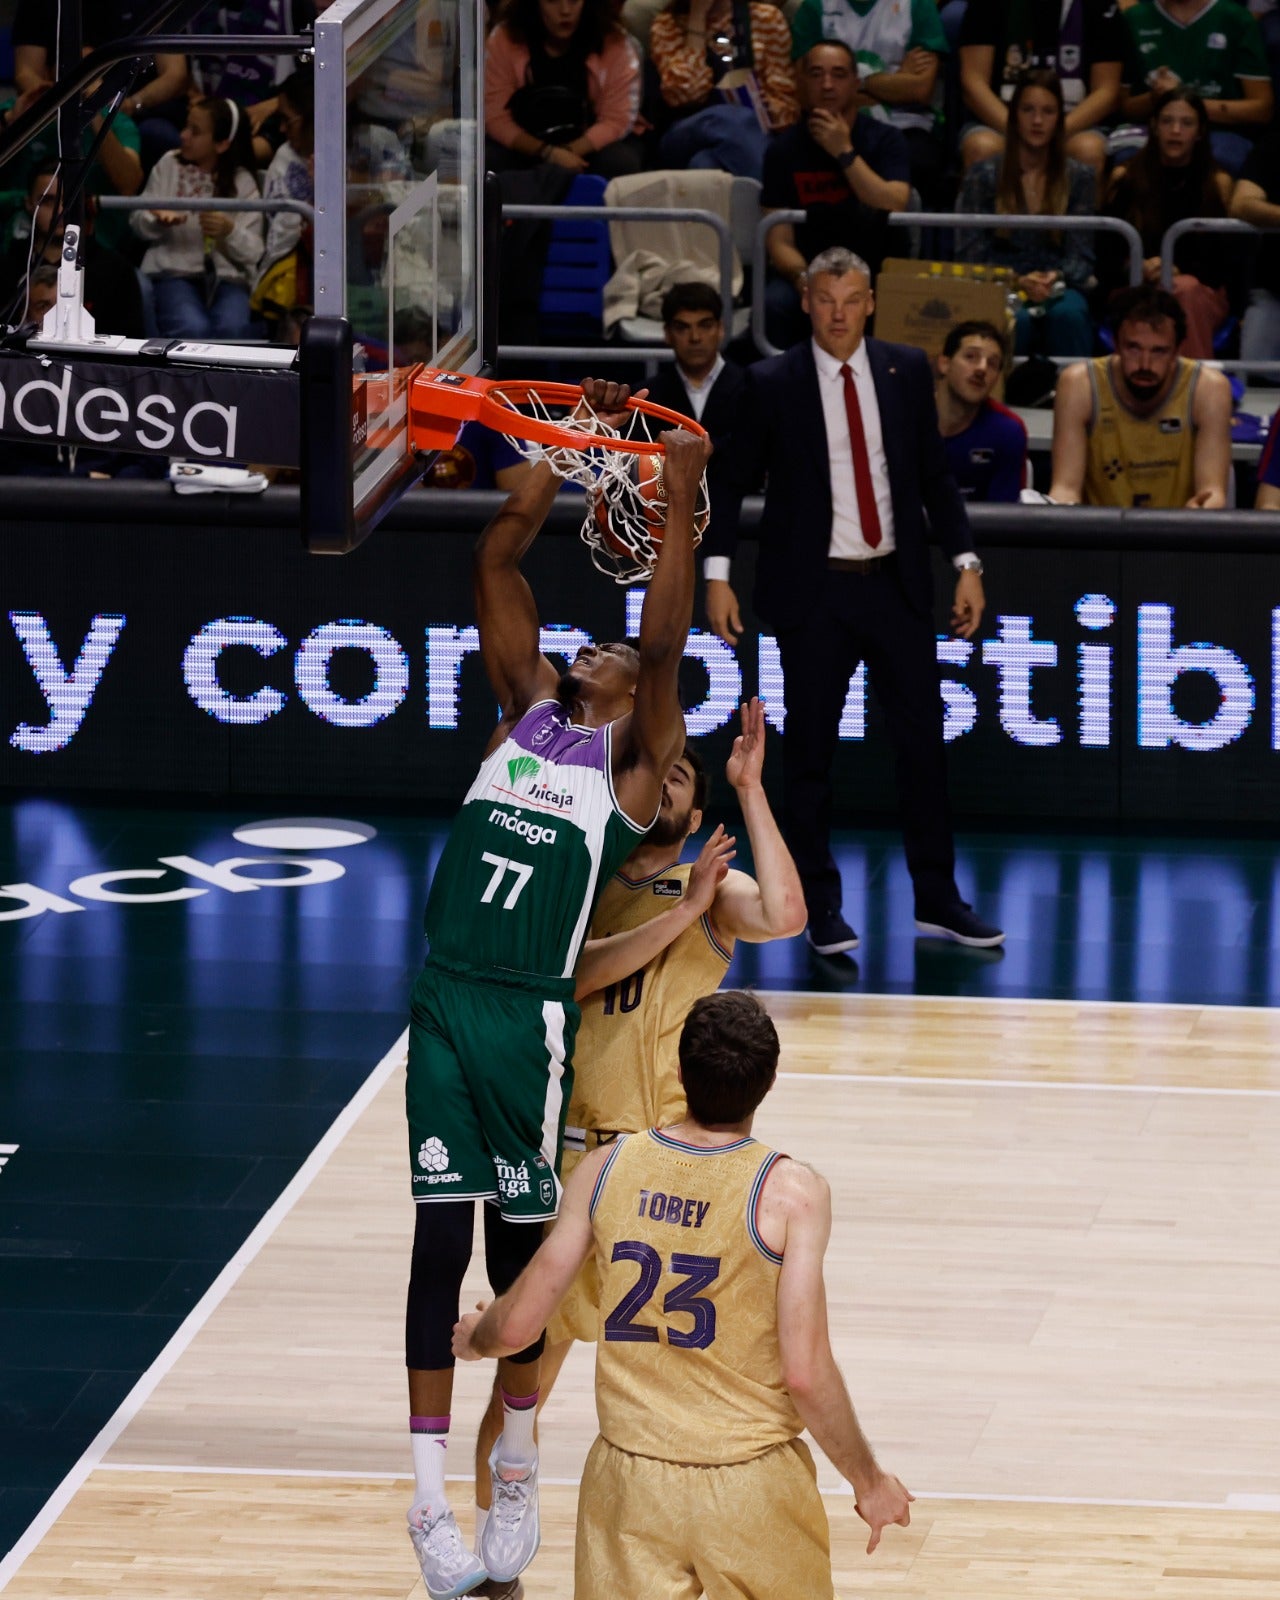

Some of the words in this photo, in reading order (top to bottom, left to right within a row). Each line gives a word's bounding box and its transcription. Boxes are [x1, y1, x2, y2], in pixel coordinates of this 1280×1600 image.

[9, 610, 127, 755] y
[180, 587, 1280, 752] cobstib
[480, 851, 535, 910] 77
[637, 1189, 711, 1229] TOBEY
[604, 1240, 722, 1351] 23
